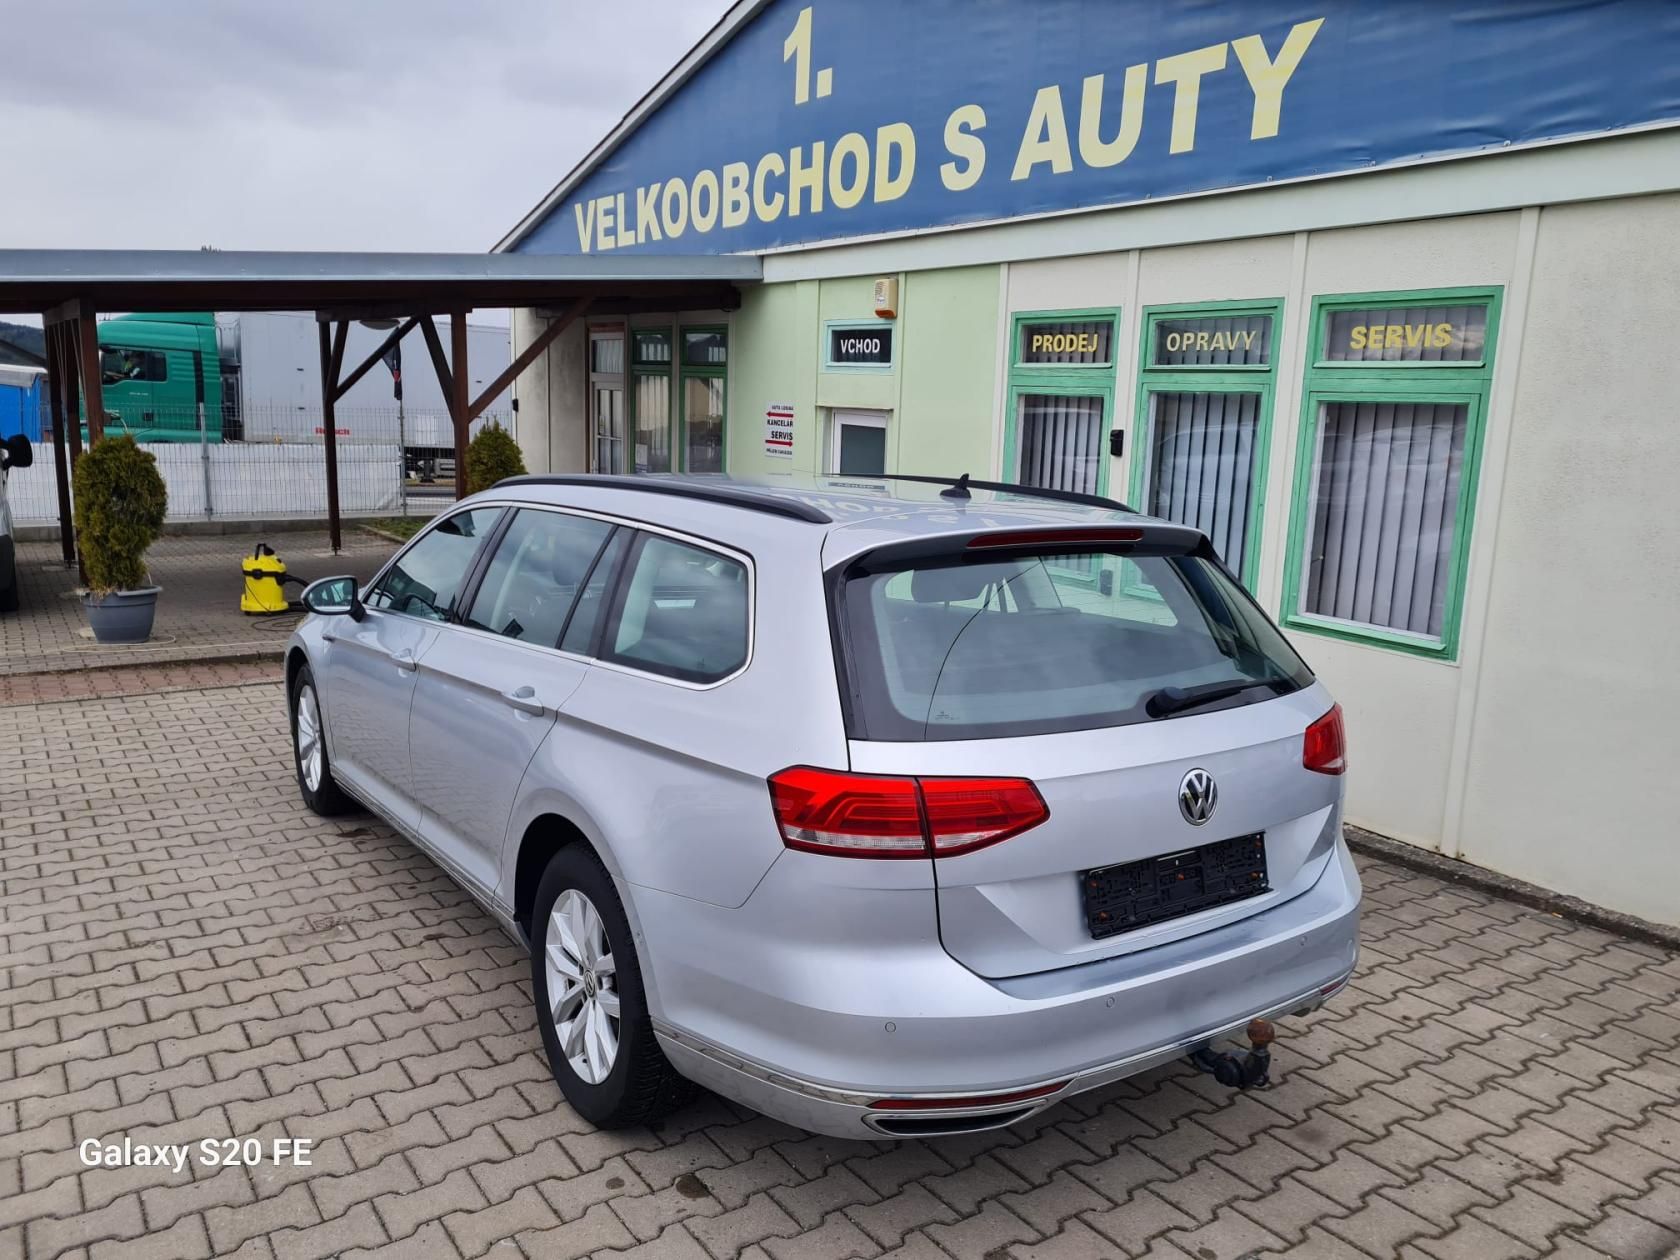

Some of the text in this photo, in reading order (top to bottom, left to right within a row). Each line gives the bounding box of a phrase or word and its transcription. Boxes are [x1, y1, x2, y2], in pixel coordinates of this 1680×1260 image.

[783, 6, 832, 105] 1.
[574, 17, 1325, 254] VELKOOBCHOD S AUTY
[840, 338, 880, 354] VCHOD
[1032, 333, 1099, 353] PRODEJ
[1166, 330, 1257, 352] OPRAVY
[1350, 323, 1452, 349] SERVIS
[771, 431, 793, 440] SERVIS
